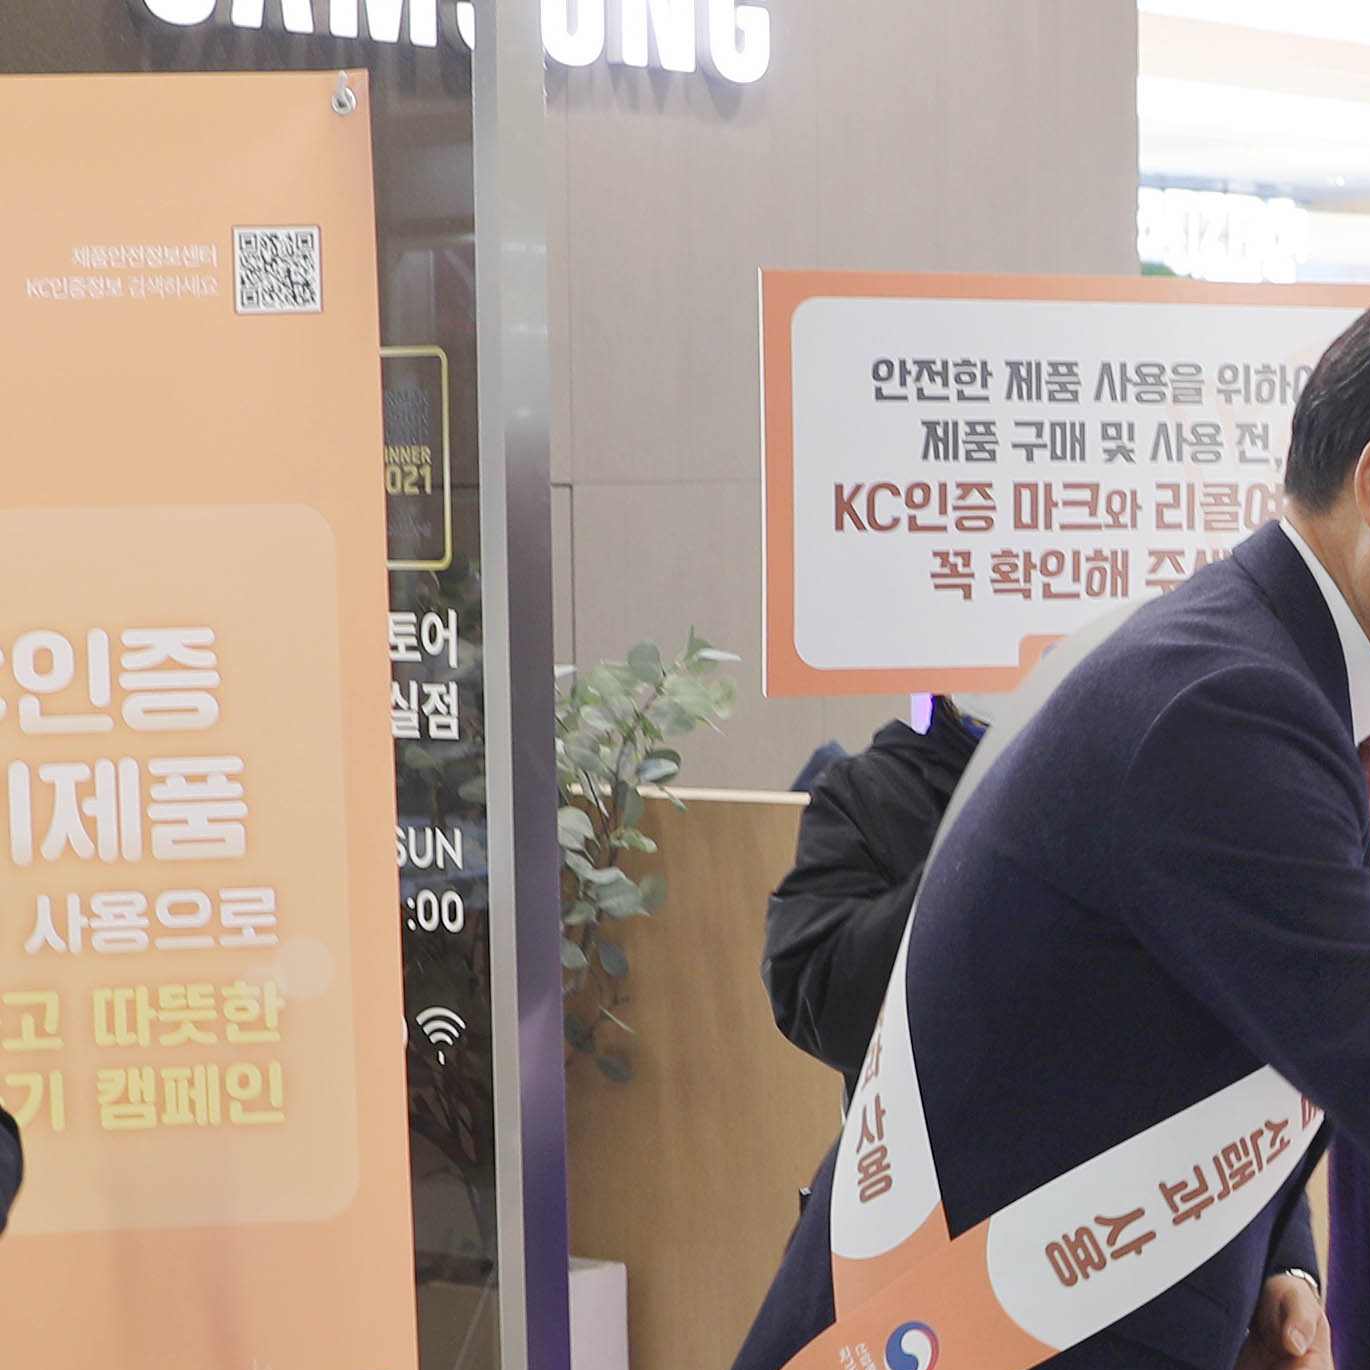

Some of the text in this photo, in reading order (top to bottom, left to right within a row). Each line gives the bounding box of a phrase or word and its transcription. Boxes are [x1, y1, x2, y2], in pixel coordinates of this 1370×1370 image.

[871, 357, 1312, 406] 안전한 제품 사용을 위하
[384, 445, 432, 465] INNER
[921, 419, 1284, 472] 제품 구매 및 사용 전,
[385, 463, 432, 495] 021
[834, 481, 1285, 534] KC인증 마크와 리콜여
[930, 550, 975, 601] 꼭
[990, 548, 1130, 602] 확인해
[0, 626, 222, 735] 인증
[24, 887, 280, 955] 사용으로
[0, 979, 286, 1050] 고 따뜻한
[0, 1059, 287, 1133] 기 캠페인
[1044, 1116, 1292, 1288] 선택과 사용
